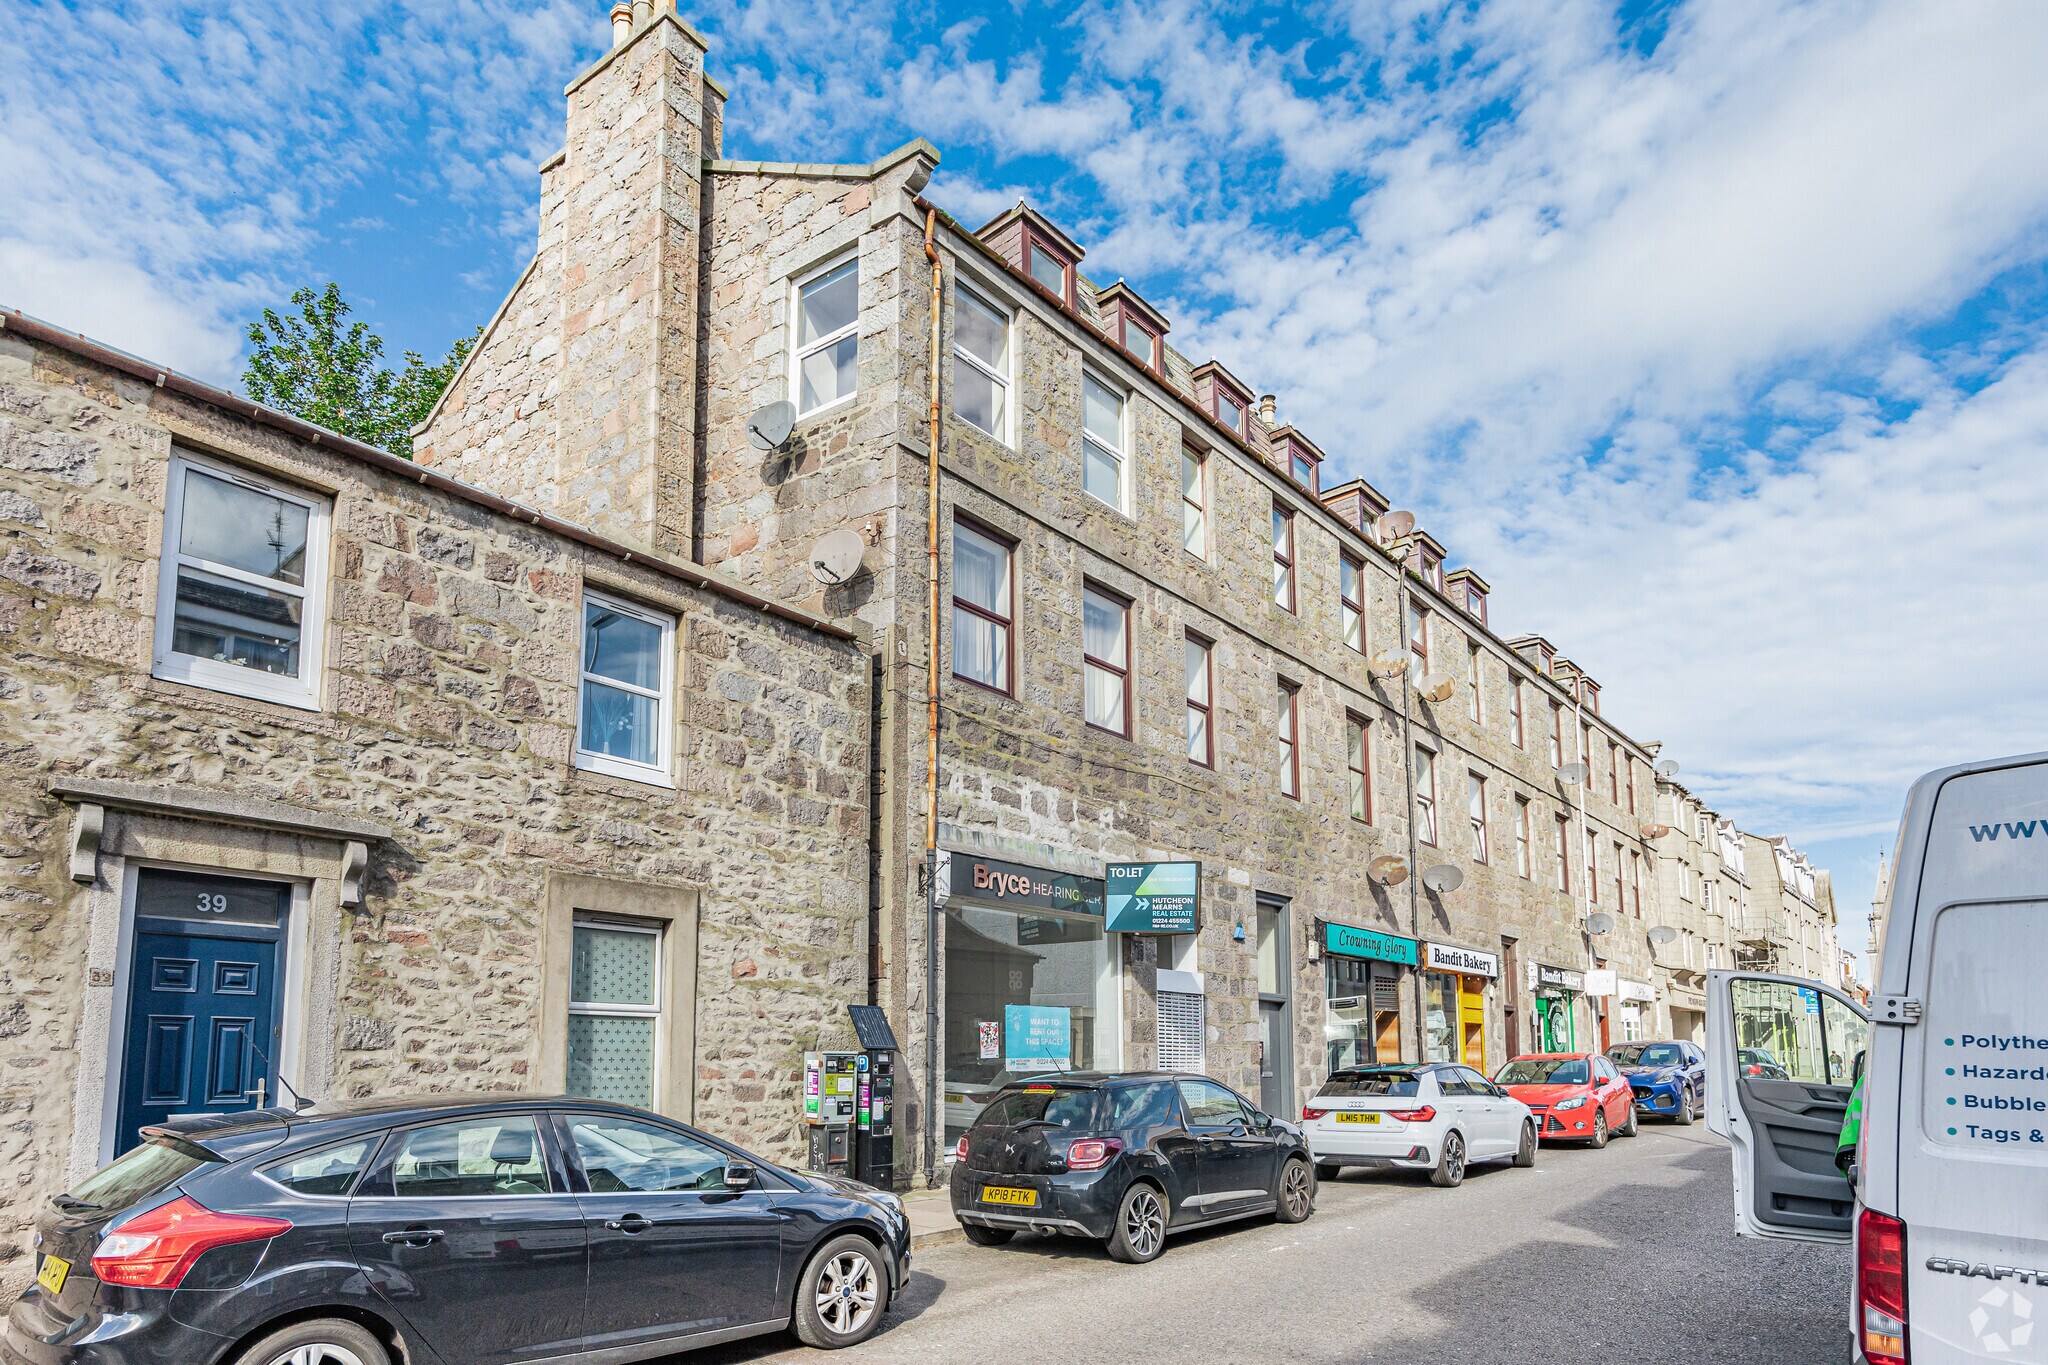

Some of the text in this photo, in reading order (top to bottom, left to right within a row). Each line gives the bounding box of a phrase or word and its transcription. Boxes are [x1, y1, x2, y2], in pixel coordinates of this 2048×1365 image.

[1968, 819, 2048, 842] ww
[1110, 867, 1143, 878] TO LET
[973, 863, 1030, 897] Bryce
[1033, 882, 1080, 900] HEARING
[196, 893, 227, 913] 39
[1339, 929, 1407, 960] Crowning Glory
[1434, 948, 1492, 974] Bandit Bakery
[1541, 967, 1561, 984] Bandit
[1561, 971, 1581, 988] Bakery
[1051, 1018, 1060, 1026] TO
[1030, 1028, 1045, 1036] RENT
[1041, 1038, 1064, 1046] SPACE?
[1962, 1035, 2048, 1051] Polythe
[1963, 1064, 2048, 1081] Hazard
[1964, 1095, 2047, 1112] Bubble
[1340, 1113, 1375, 1122] LM15 THM
[1965, 1125, 2045, 1143] Tags &
[988, 1188, 1030, 1202] KP18 FTK
